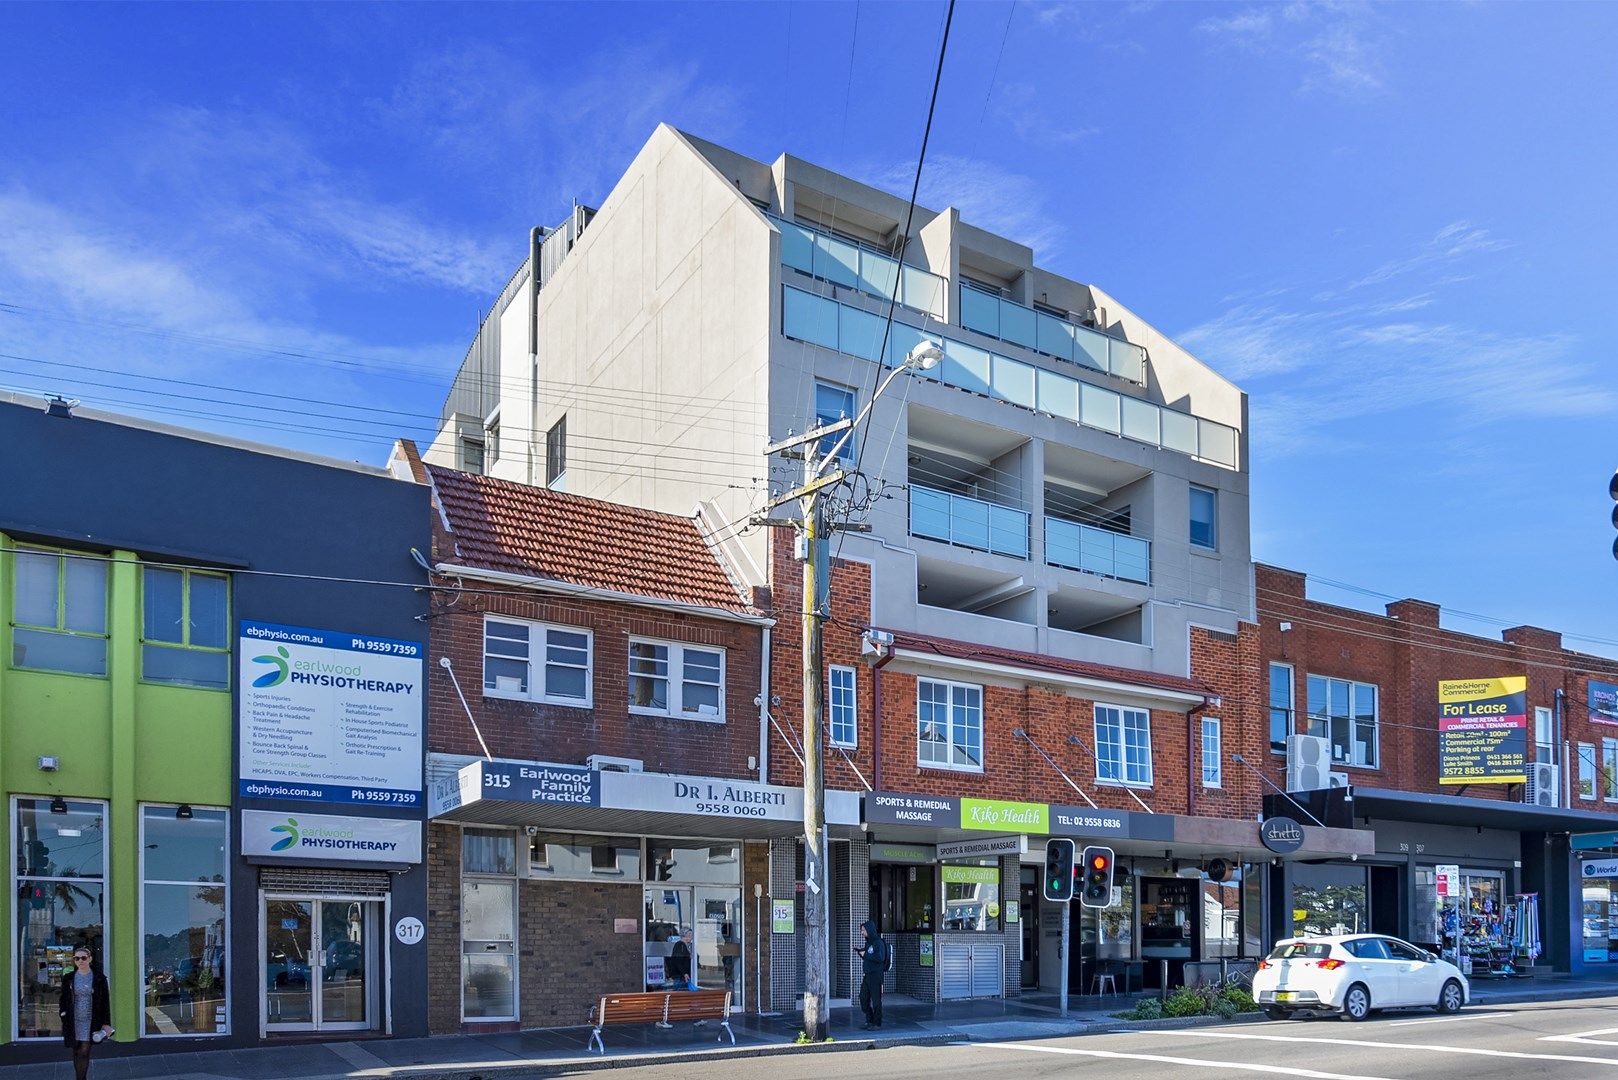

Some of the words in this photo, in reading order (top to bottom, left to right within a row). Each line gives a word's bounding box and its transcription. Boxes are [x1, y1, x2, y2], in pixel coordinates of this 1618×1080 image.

[246, 626, 324, 644] ebphysio.com.au
[352, 638, 365, 649] Ph
[367, 640, 391, 652] 9559
[393, 644, 417, 655] 7359
[294, 660, 361, 676] earlwood
[291, 672, 413, 694] PHYSIOTHERAPY
[1443, 704, 1465, 715] For
[1468, 703, 1507, 714] Lease
[484, 774, 511, 788] 315
[520, 768, 590, 783] Earlwood
[246, 784, 322, 797] ebphysio.com.au
[541, 780, 591, 795] Family
[352, 790, 365, 800] Ph
[366, 791, 391, 801] 9559
[392, 792, 416, 803] 7359
[532, 789, 591, 803] Practice
[707, 785, 718, 800] I.
[723, 786, 786, 805] ALBERTI
[696, 803, 730, 813] 9558
[734, 806, 766, 816] 0060
[876, 796, 905, 807] SPORTS
[906, 799, 913, 807] &
[914, 800, 951, 811] REMEDIAL
[896, 811, 932, 821] MASSAGE
[971, 806, 998, 824] Kiko
[1001, 808, 1040, 824] Health
[1057, 815, 1073, 825] TEL:
[1074, 817, 1083, 826] 02
[1085, 817, 1102, 827] 9558
[1103, 819, 1121, 828] 6836
[302, 827, 354, 838] earlwood
[302, 838, 396, 851] PHYSIOTHERAPY
[940, 847, 958, 855] SPORTS
[964, 844, 989, 853] REMEDIAL
[991, 841, 1016, 850] MASSAGE
[946, 870, 965, 880] Kiko
[967, 870, 994, 879] Health
[399, 925, 421, 937] 317
